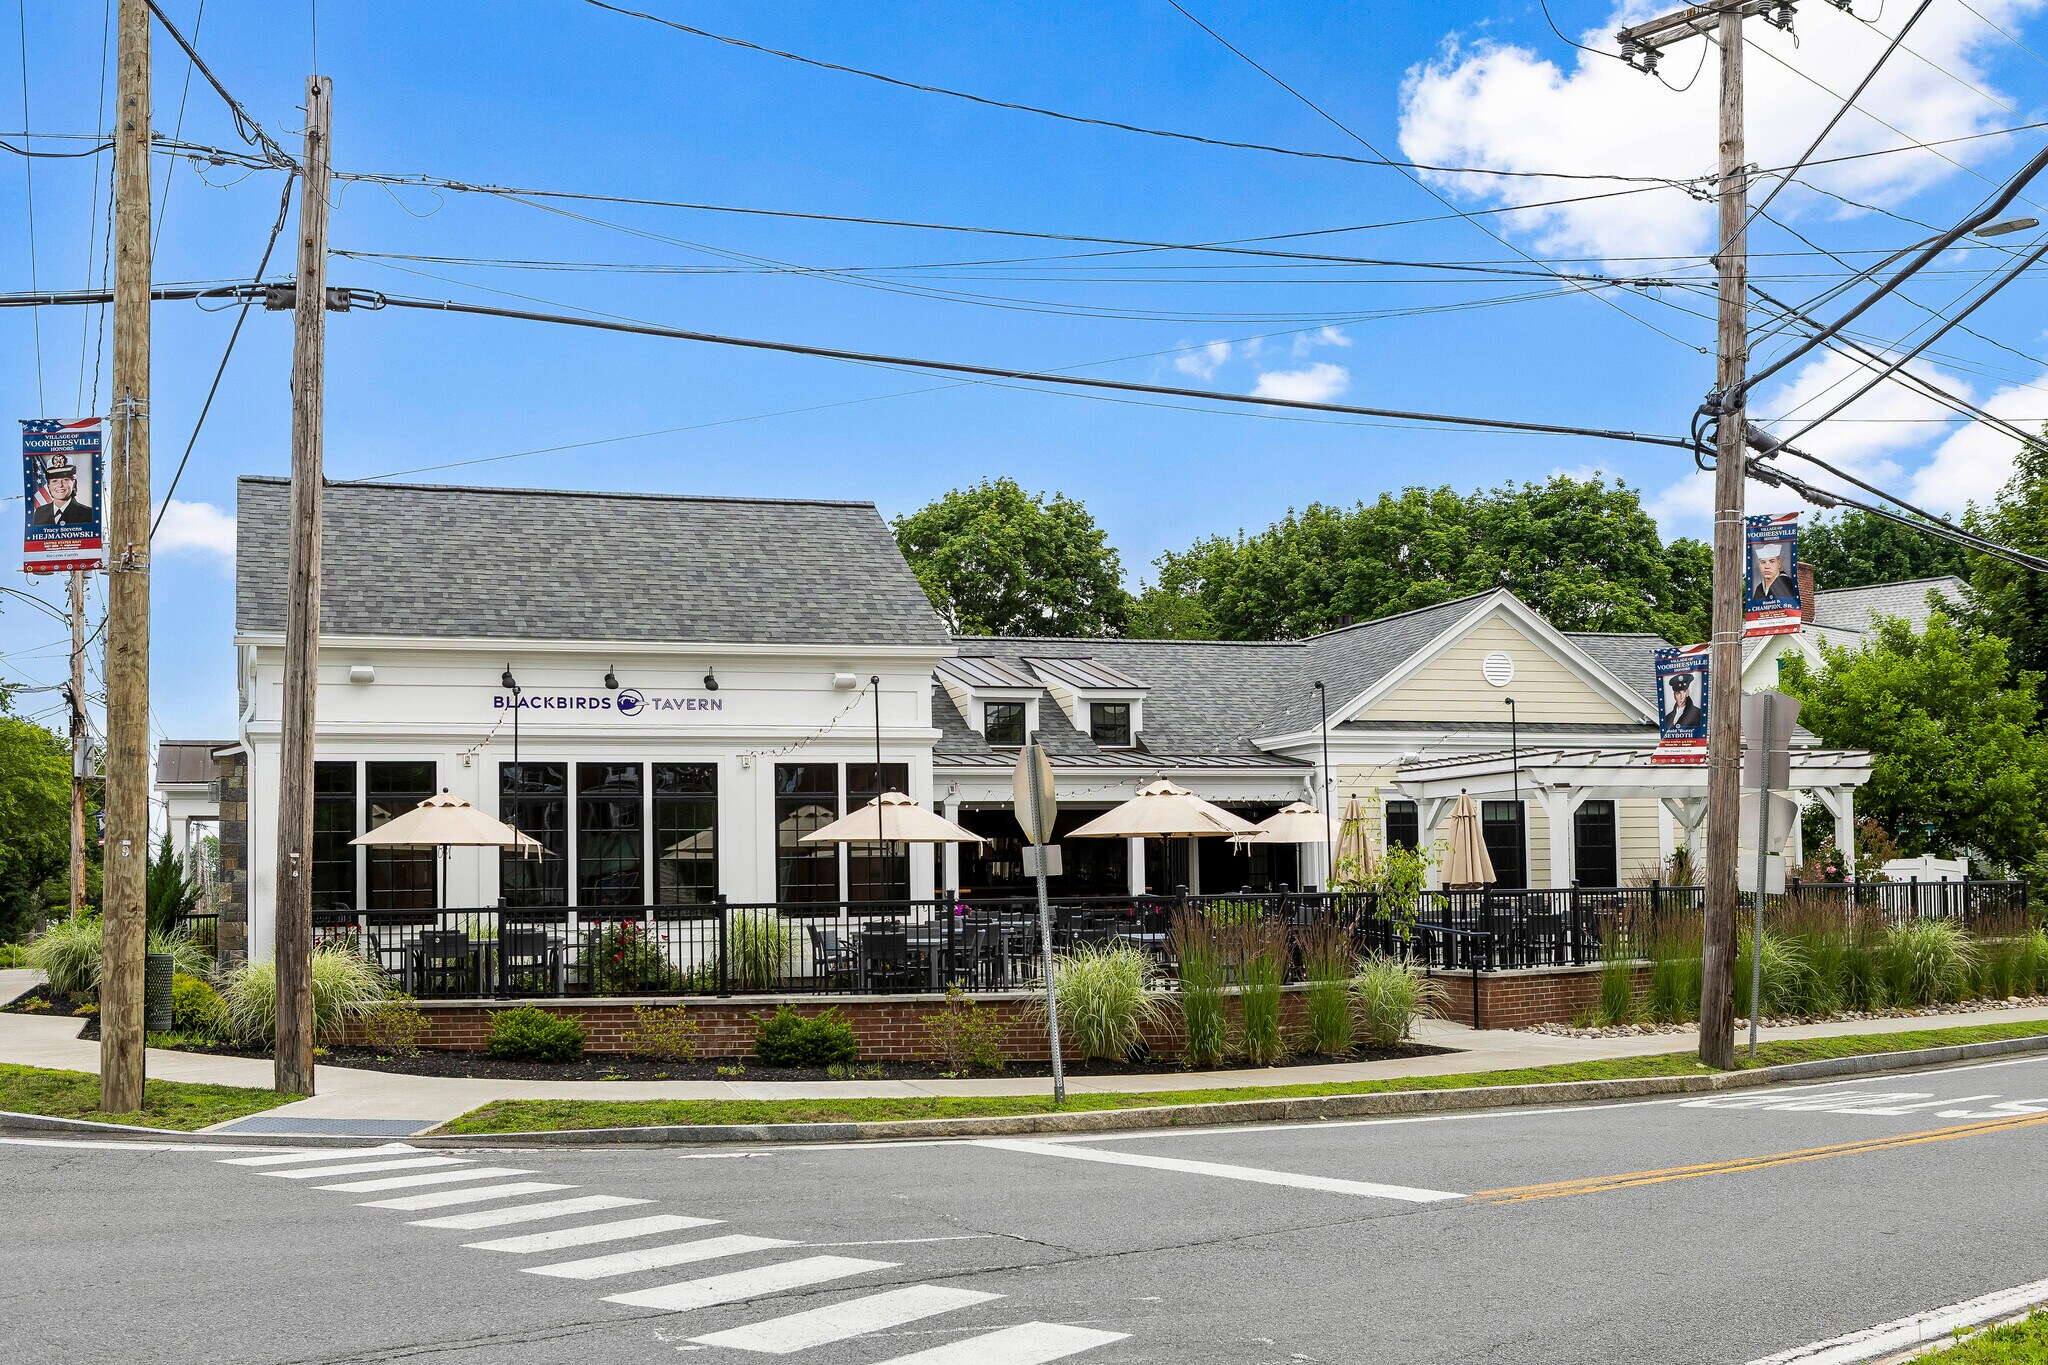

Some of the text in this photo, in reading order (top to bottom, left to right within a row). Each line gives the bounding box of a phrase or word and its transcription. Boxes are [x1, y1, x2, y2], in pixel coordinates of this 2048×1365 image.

[25, 438, 100, 447] VOORHEESVILLE
[32, 531, 94, 540] HEJMANOWSKI
[1747, 529, 1796, 538] VOORHEESVILLE
[1657, 659, 1708, 670] VOORHEESVILLE
[493, 695, 723, 711] BLACKBIRDS TAVERN
